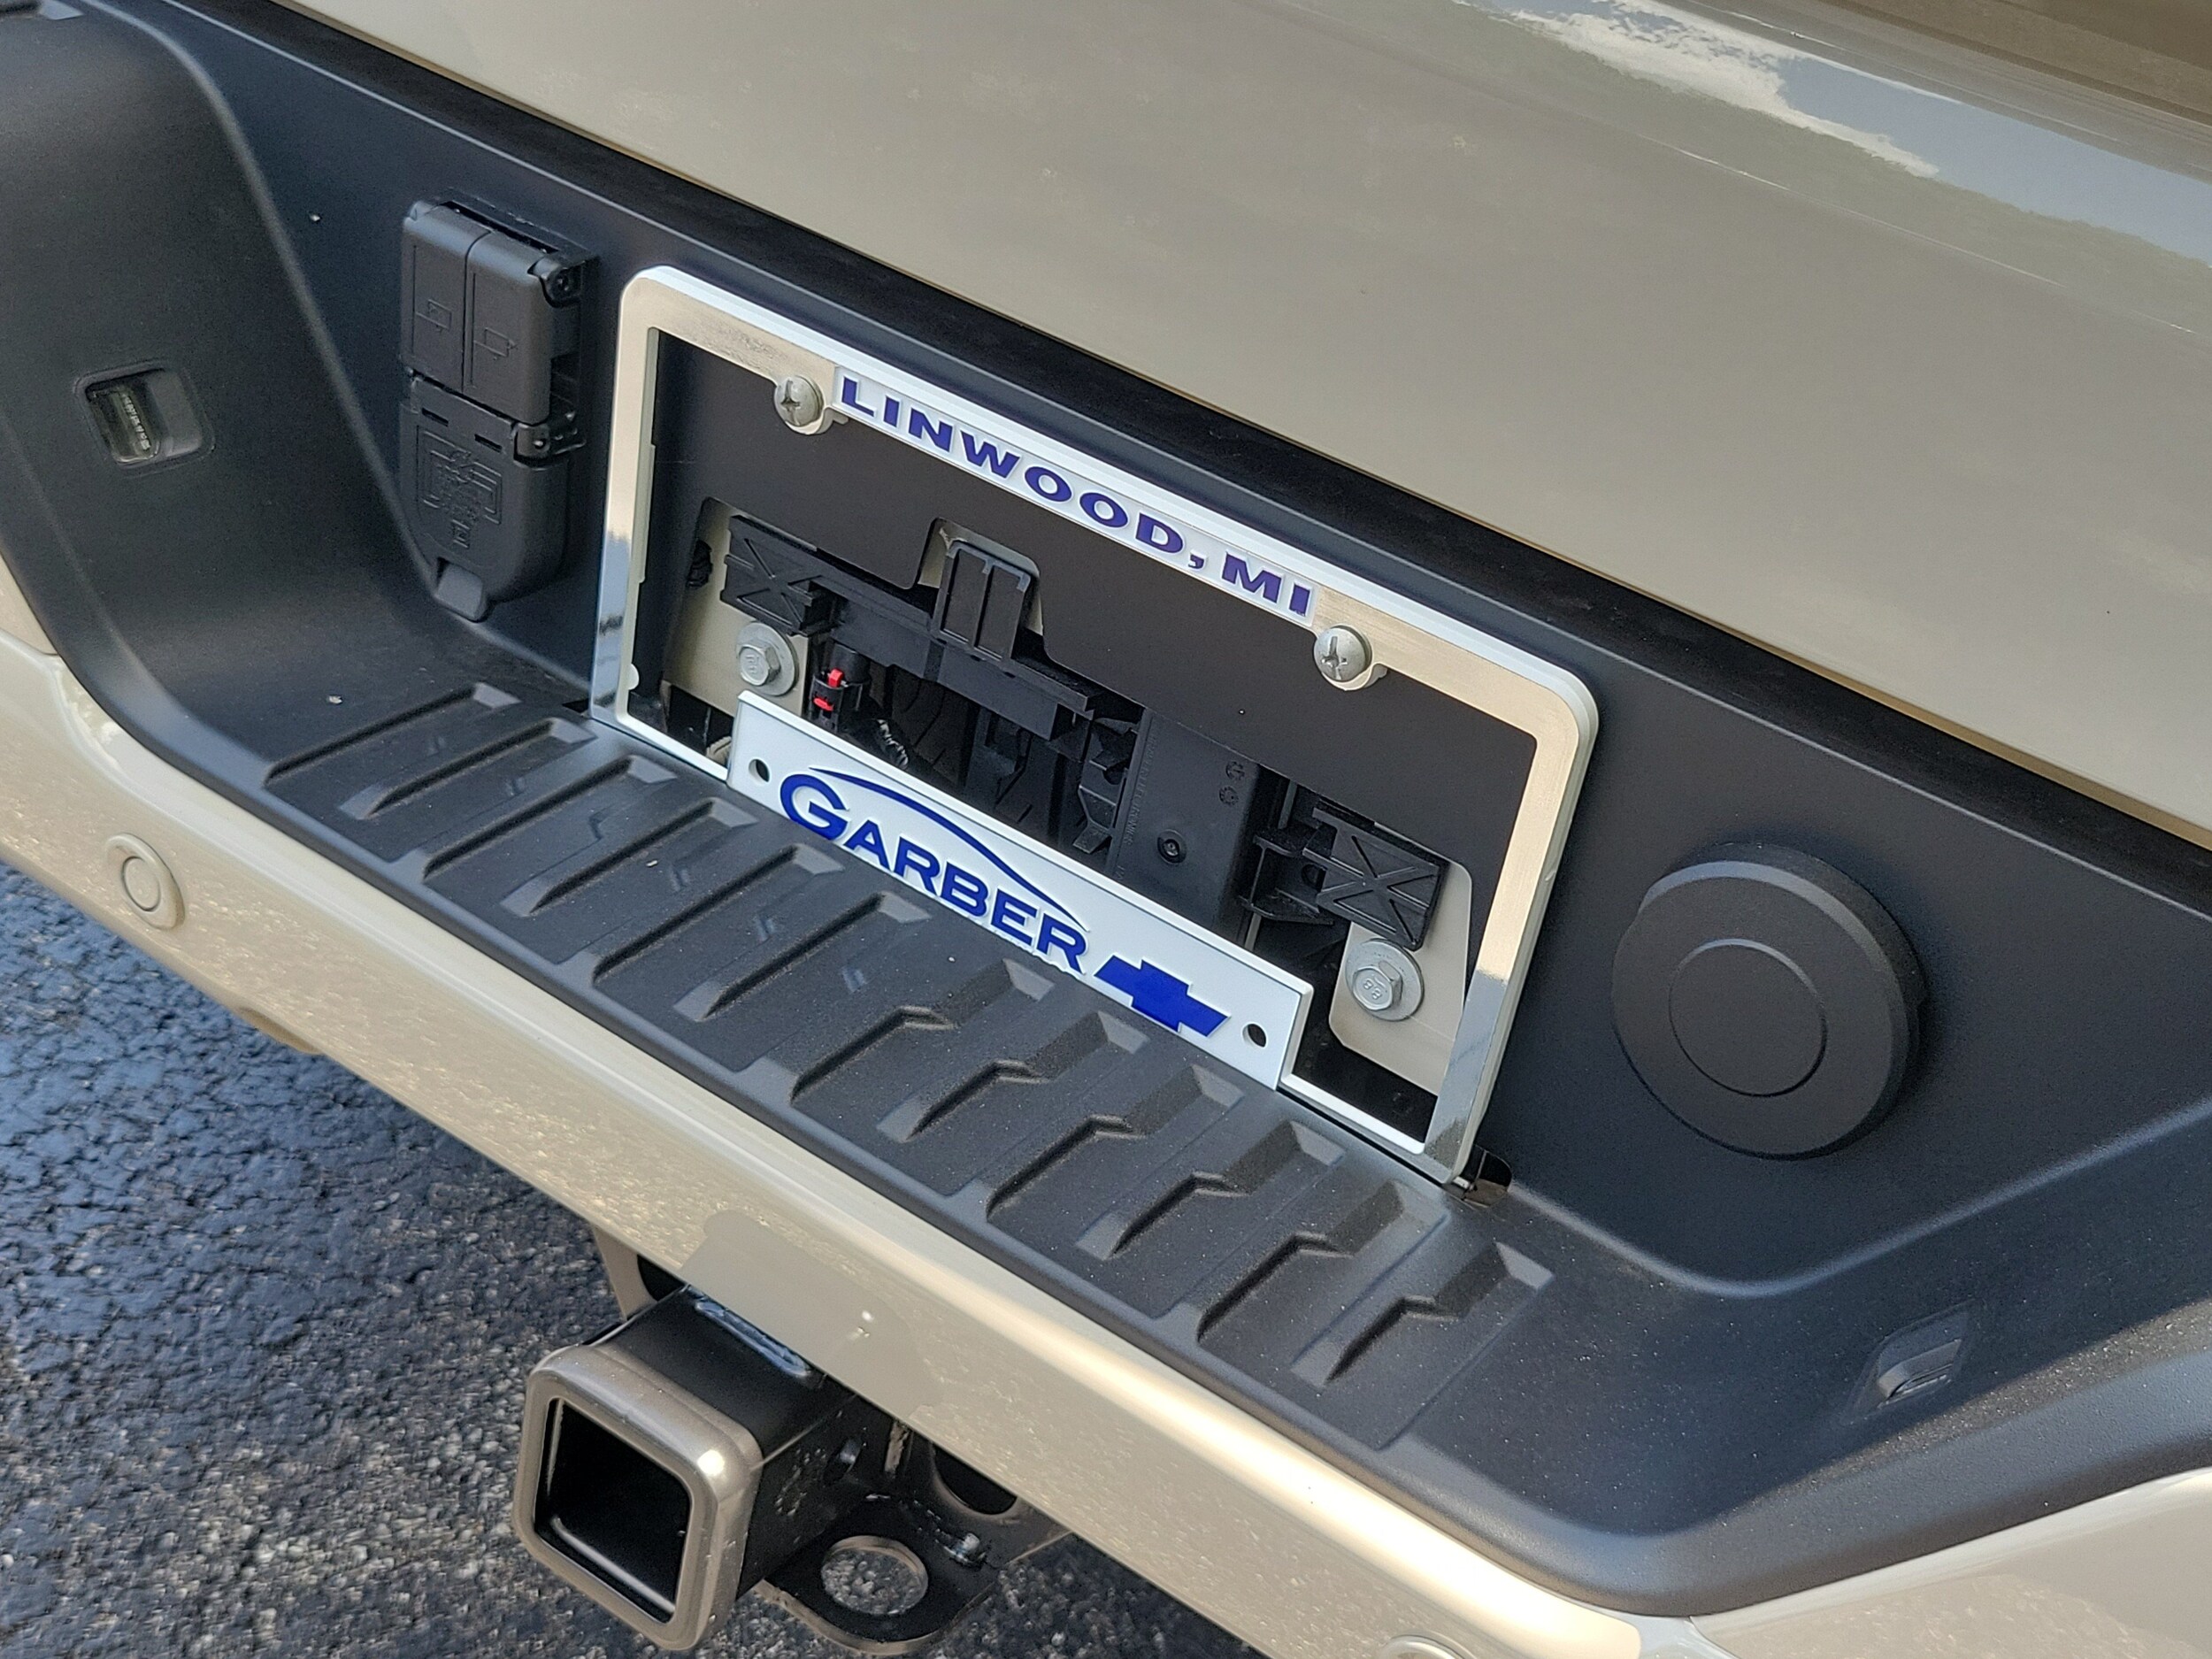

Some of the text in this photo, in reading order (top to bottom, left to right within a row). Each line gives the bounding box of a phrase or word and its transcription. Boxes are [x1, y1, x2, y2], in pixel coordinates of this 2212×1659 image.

[841, 376, 1311, 618] LINWOOD, MI
[780, 773, 1087, 974] GARBER
